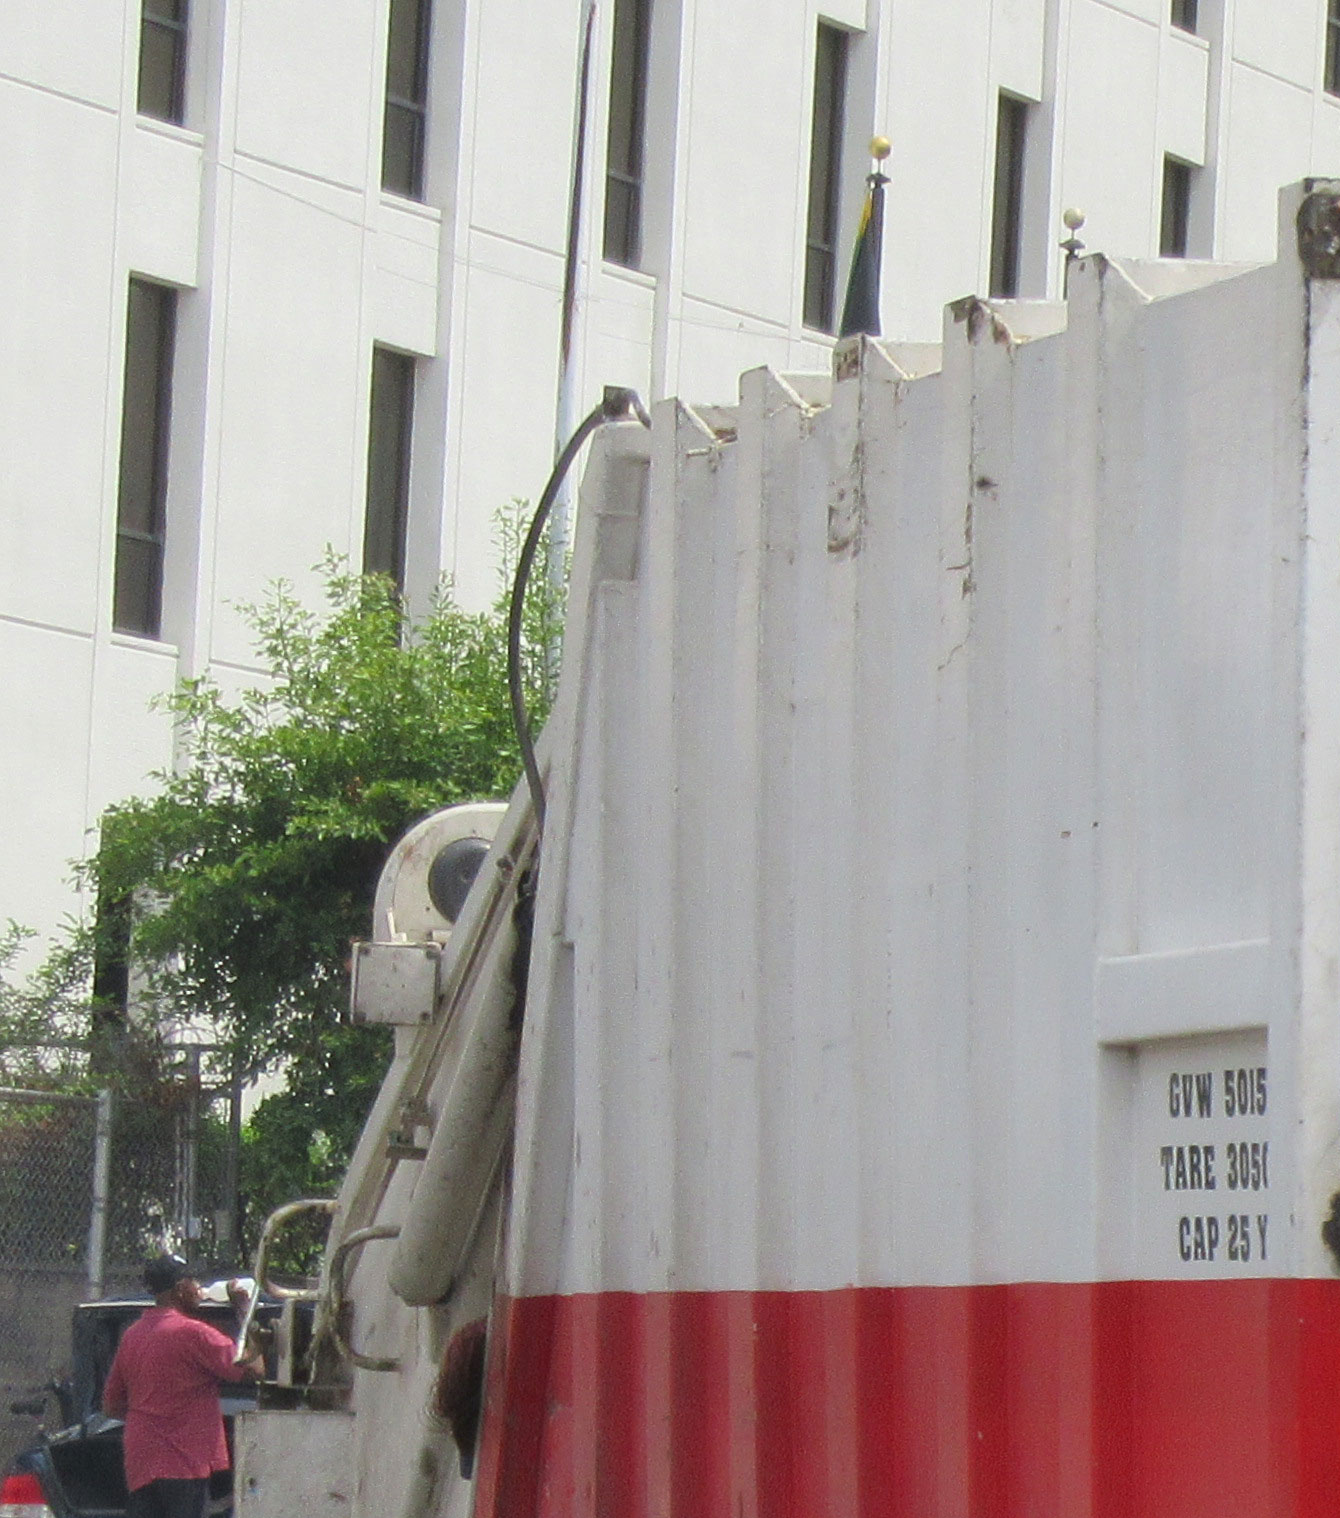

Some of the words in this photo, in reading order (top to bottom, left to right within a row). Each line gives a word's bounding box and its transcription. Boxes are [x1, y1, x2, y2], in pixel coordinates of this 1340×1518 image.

[1169, 1072, 1213, 1118] GVW
[1160, 1145, 1216, 1191] TARE
[1179, 1216, 1219, 1262] CAP
[1227, 1214, 1251, 1262] 25
